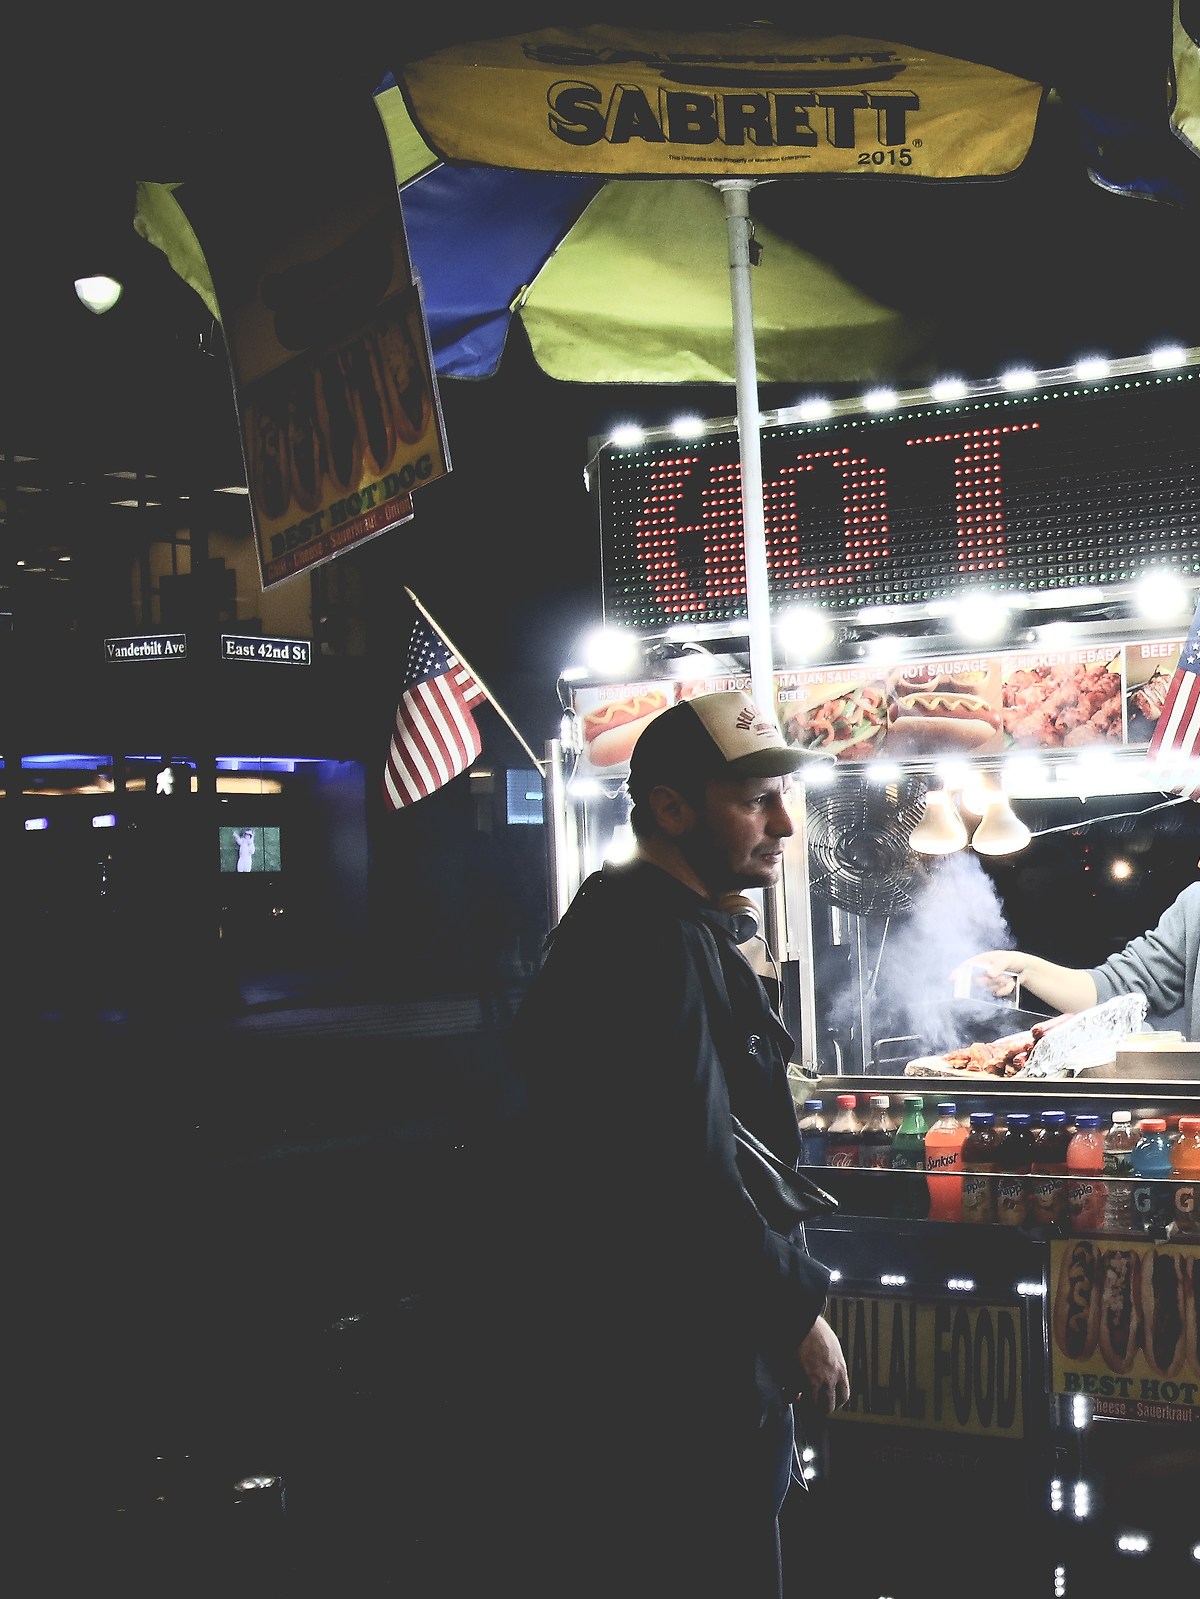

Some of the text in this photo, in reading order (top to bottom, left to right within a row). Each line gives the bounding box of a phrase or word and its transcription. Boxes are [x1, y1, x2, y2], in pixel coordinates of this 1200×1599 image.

[547, 80, 920, 148] SABRETT
[858, 148, 912, 166] 2015
[270, 454, 433, 557] BEST HOT DOG
[107, 641, 184, 657] Vanderbilt Ave
[226, 641, 307, 660] East 42nd St
[1069, 648, 1117, 664] KEBAB
[1141, 643, 1176, 659] BEEF
[779, 667, 884, 688] ITALIAN SAUSAGE
[899, 660, 988, 679] HOT SAUSAGE
[927, 1152, 960, 1171] Sunkist
[934, 1303, 1017, 1429] FOOD
[1063, 1371, 1133, 1398] BEST
[1139, 1378, 1199, 1404] HOT
[1137, 1402, 1192, 1422] Sauerkraut
